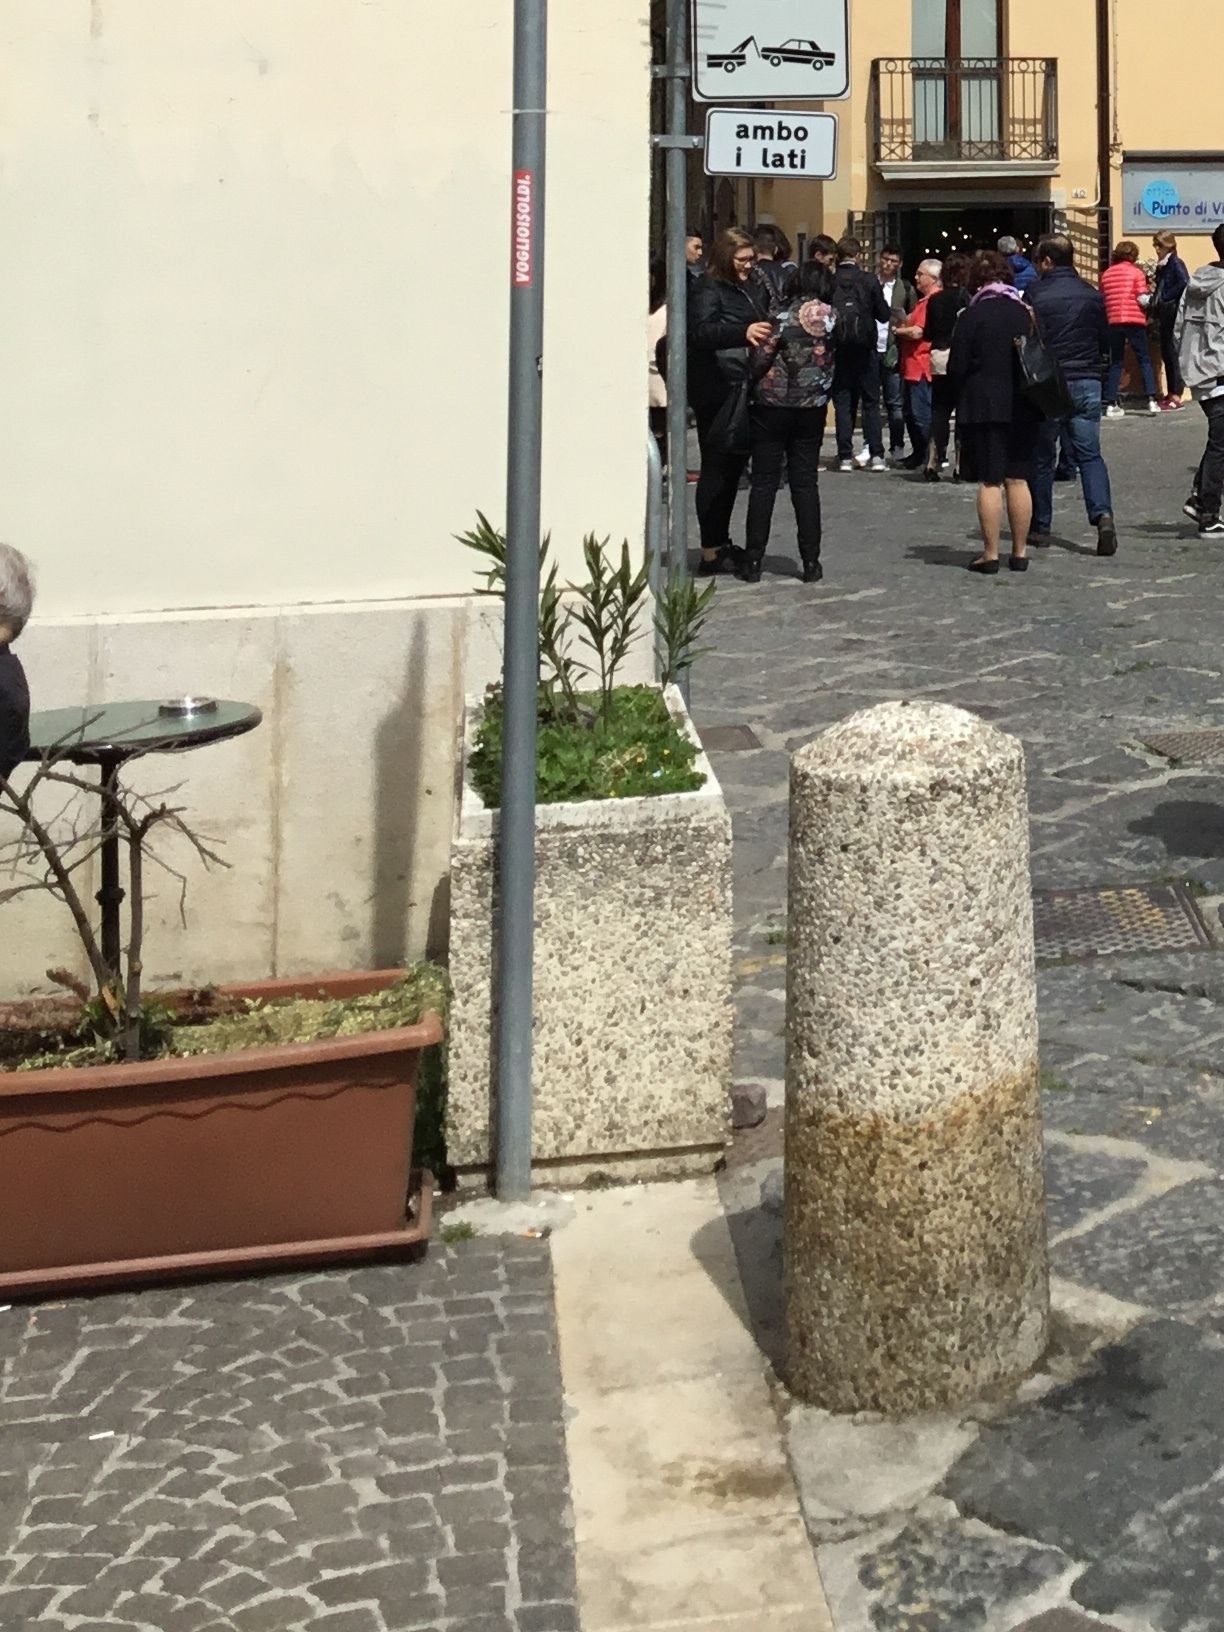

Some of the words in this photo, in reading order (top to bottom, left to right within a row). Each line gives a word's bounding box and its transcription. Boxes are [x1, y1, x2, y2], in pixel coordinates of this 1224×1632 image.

[735, 120, 809, 142] ambo
[736, 146, 743, 167] i
[762, 147, 806, 170] lati
[1133, 200, 1142, 216] il
[1152, 200, 1191, 216] Punto
[1194, 201, 1208, 216] di
